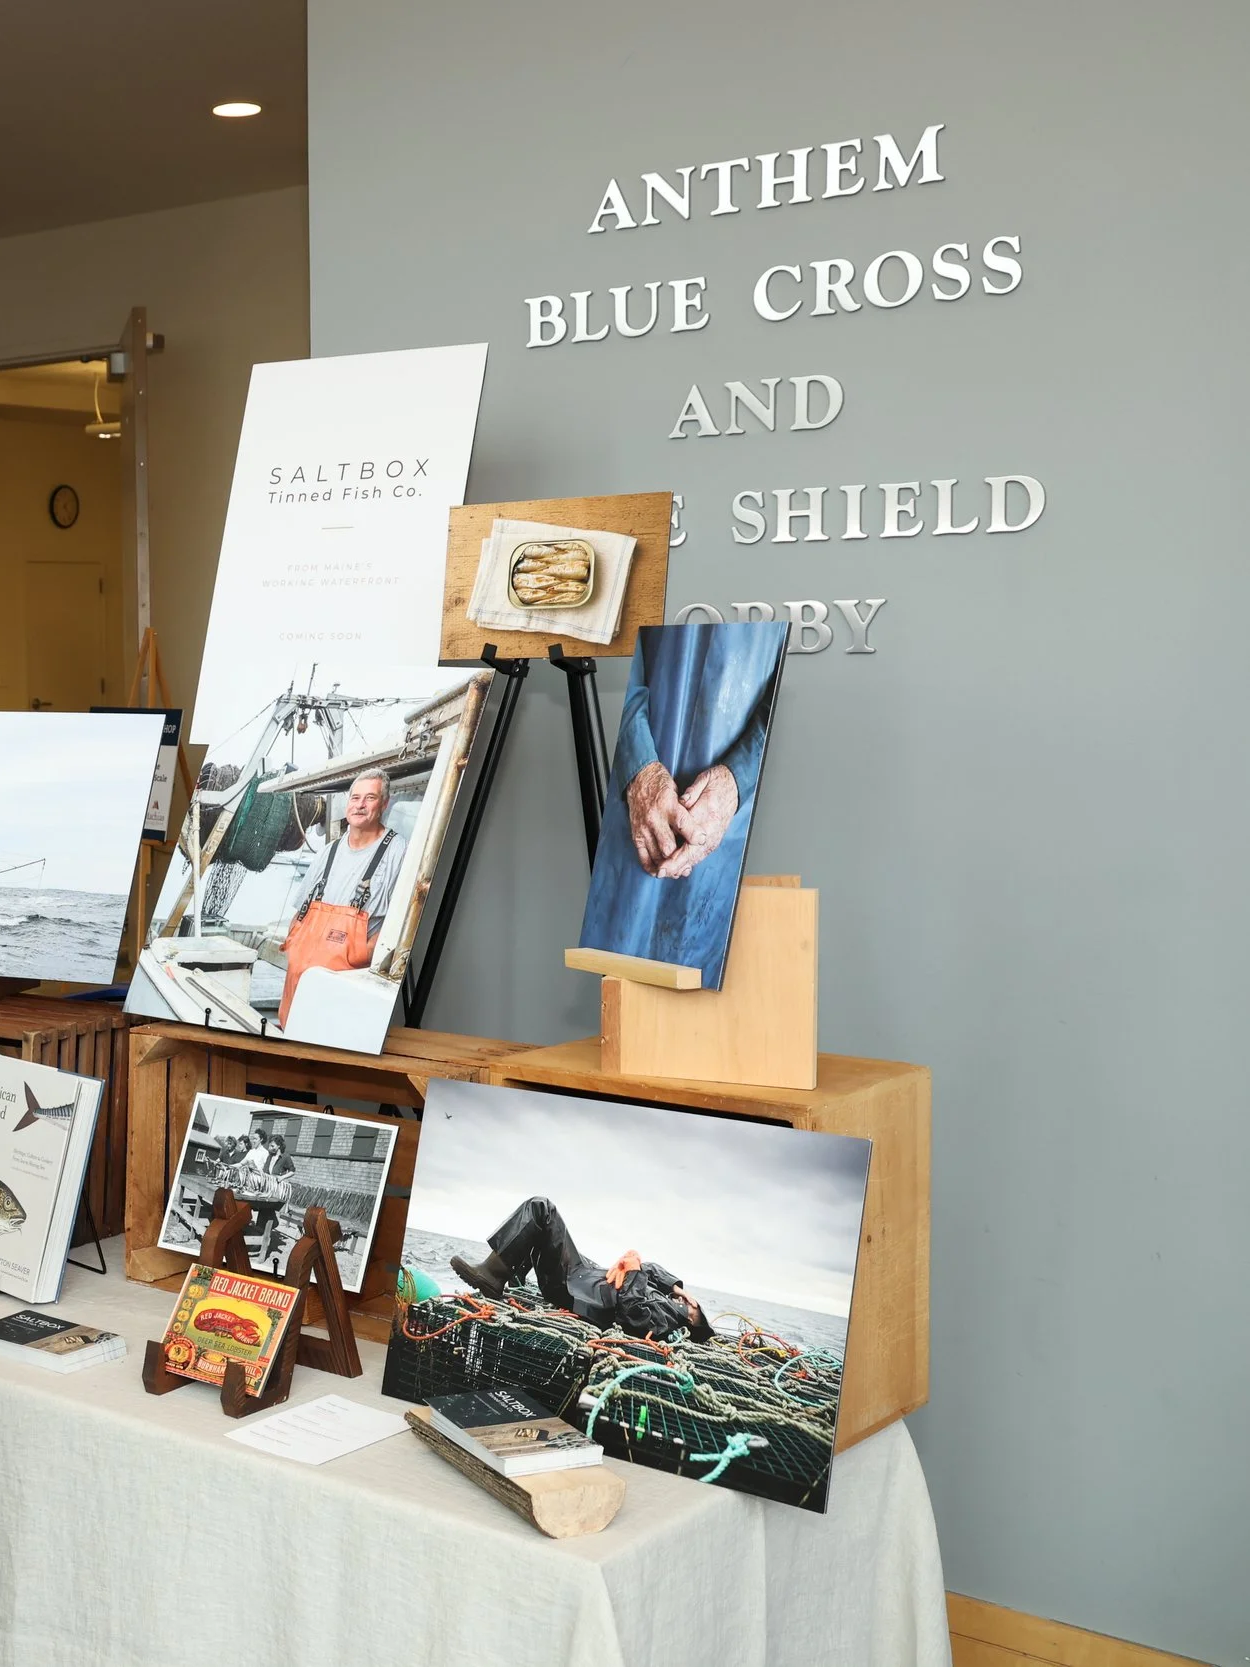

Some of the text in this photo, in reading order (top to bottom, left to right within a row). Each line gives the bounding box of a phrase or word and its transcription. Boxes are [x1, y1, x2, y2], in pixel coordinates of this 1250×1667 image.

[587, 123, 946, 234] ANTHEM
[524, 235, 1024, 349] BLUE CROSS
[668, 374, 844, 440] AND
[269, 458, 429, 485] SALTBOX
[268, 485, 422, 504] Tinned Fish Co.
[731, 474, 1047, 545] SHIELD
[211, 1276, 291, 1309] RED JACKET BRAND
[15, 1314, 66, 1330] SALTBOX
[200, 1312, 213, 1321] RED
[494, 1390, 537, 1418] SALTBOX
